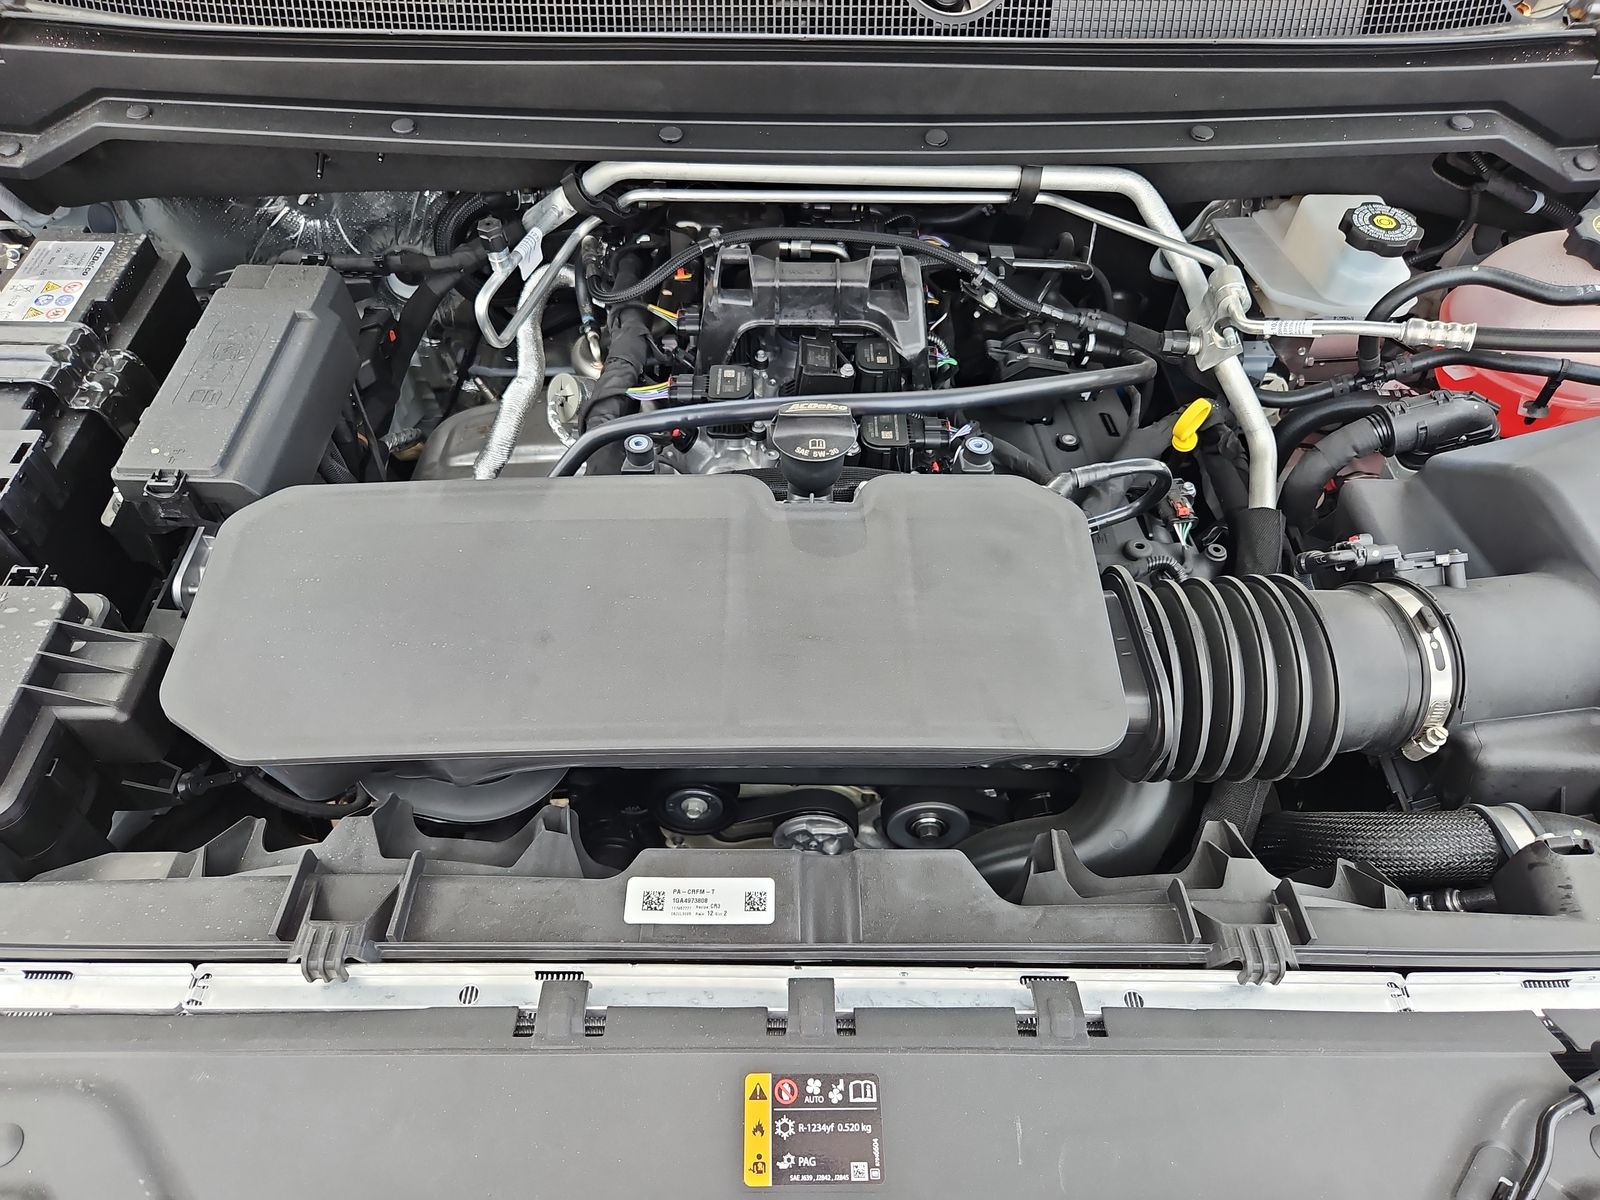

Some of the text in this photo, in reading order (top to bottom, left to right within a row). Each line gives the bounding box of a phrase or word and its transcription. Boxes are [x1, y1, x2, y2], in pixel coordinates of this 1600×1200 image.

[786, 403, 848, 411] ACDelco
[794, 446, 840, 457] SAE 5W-30
[804, 1095, 825, 1103] AUTO
[798, 1122, 872, 1134] R-1234yf 0.520 kg
[798, 1156, 817, 1166] PAG
